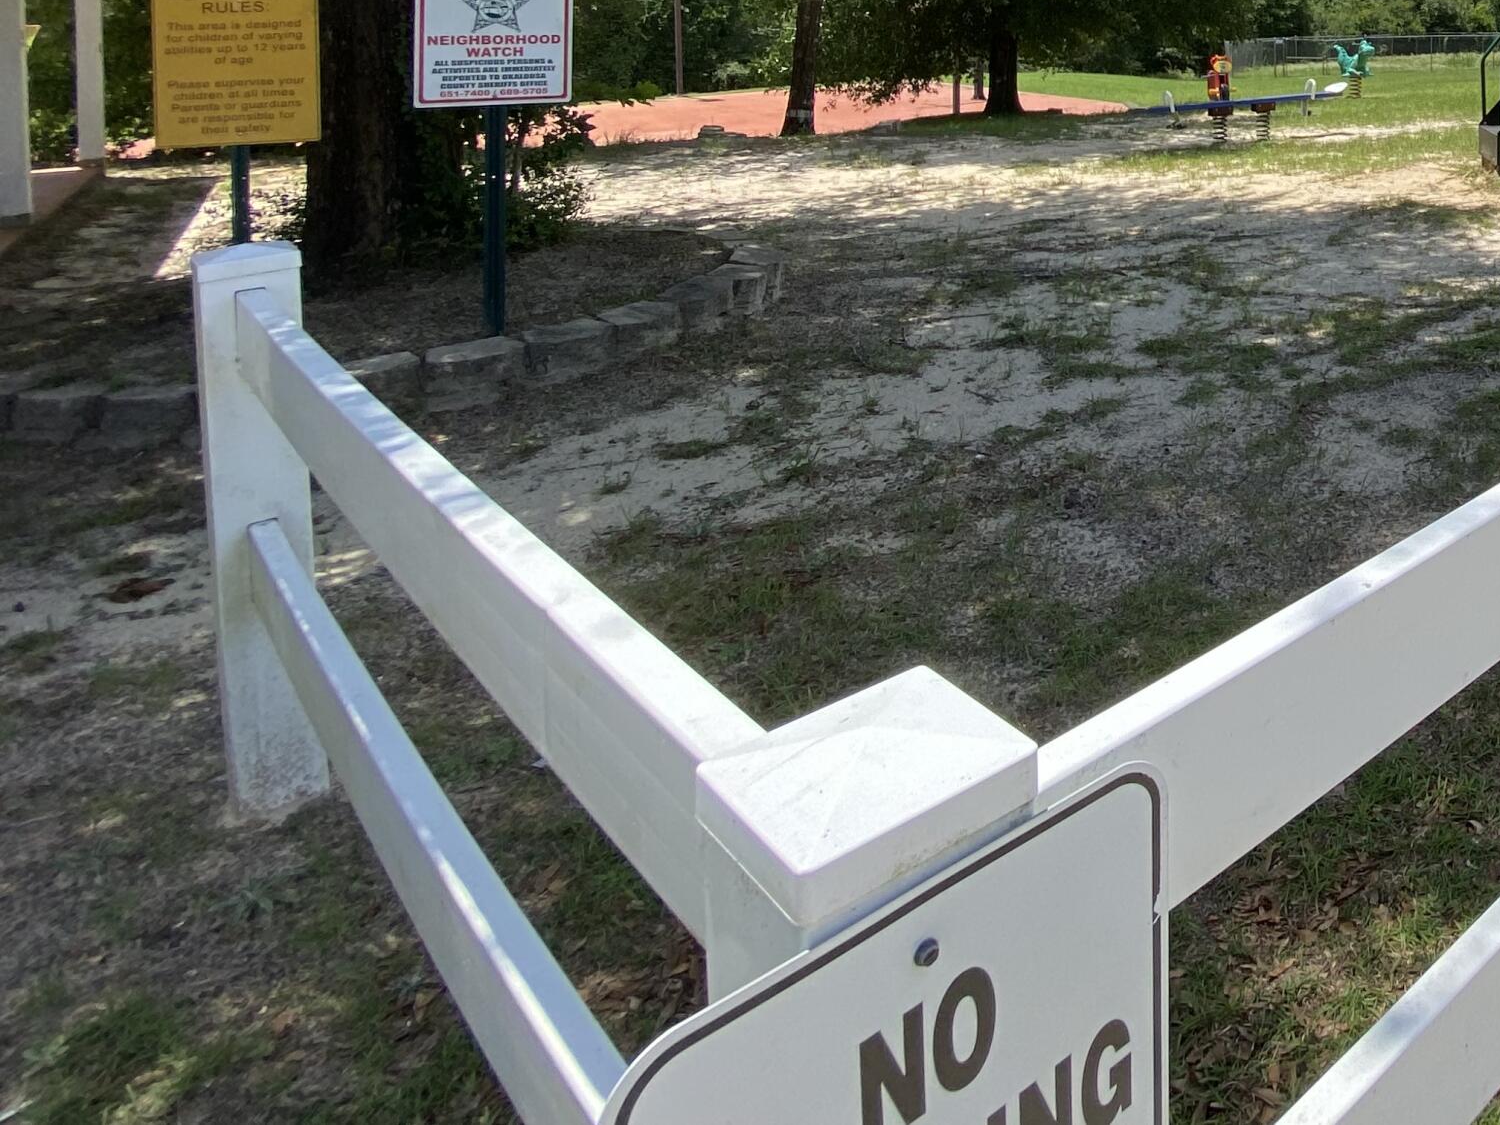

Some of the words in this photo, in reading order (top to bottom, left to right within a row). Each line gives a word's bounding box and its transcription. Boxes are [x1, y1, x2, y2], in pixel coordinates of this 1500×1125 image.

[202, 1, 270, 13] RULES:
[168, 22, 194, 31] This
[232, 21, 240, 29] is
[246, 19, 302, 31] designed
[166, 34, 182, 43] for
[188, 32, 238, 43] children
[242, 32, 254, 40] of
[258, 31, 303, 42] varying
[427, 34, 562, 46] NEIGHBORHOOD
[164, 45, 212, 55] abilities
[217, 46, 232, 54] up
[237, 44, 248, 52] to
[254, 43, 268, 51] 12
[272, 43, 306, 53] years
[466, 47, 524, 57] WATCH
[214, 56, 227, 64] of
[231, 57, 253, 65] age
[168, 80, 210, 89] Please
[214, 78, 274, 88] supervise
[278, 77, 305, 86] your
[173, 91, 223, 101] children
[228, 90, 239, 99] at
[244, 90, 258, 98] all
[171, 103, 220, 112] Parents
[241, 99, 302, 111] guardians
[178, 116, 198, 124] are
[203, 111, 275, 123] responsible
[280, 111, 295, 119] for
[202, 125, 228, 134] their
[859, 966, 997, 1125] NO
